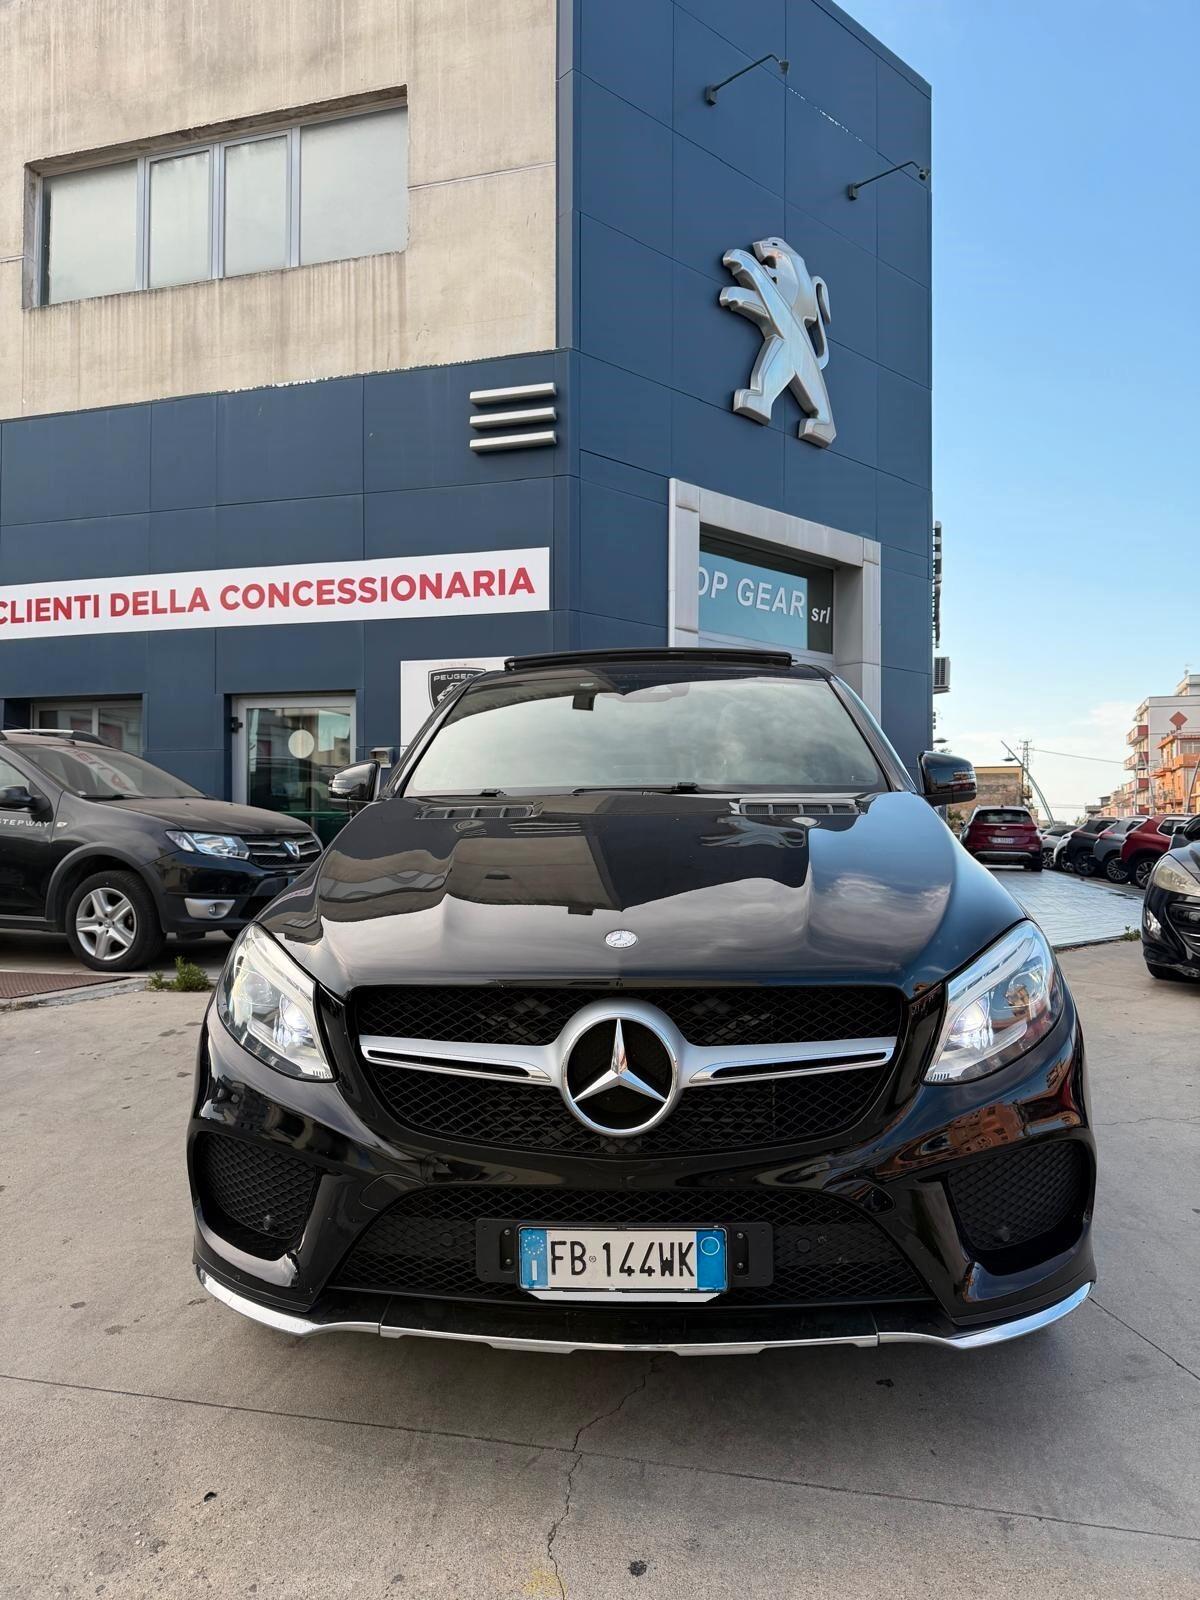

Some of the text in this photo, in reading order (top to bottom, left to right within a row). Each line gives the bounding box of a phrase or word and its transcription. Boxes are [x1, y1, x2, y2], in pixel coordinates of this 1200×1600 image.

[110, 587, 210, 617] DELLA
[219, 567, 536, 611] CONCESSIONARIA
[737, 578, 805, 618] GEAR
[811, 607, 831, 624] srl
[0, 818, 50, 828] TEPWAY
[550, 1240, 587, 1276] FB
